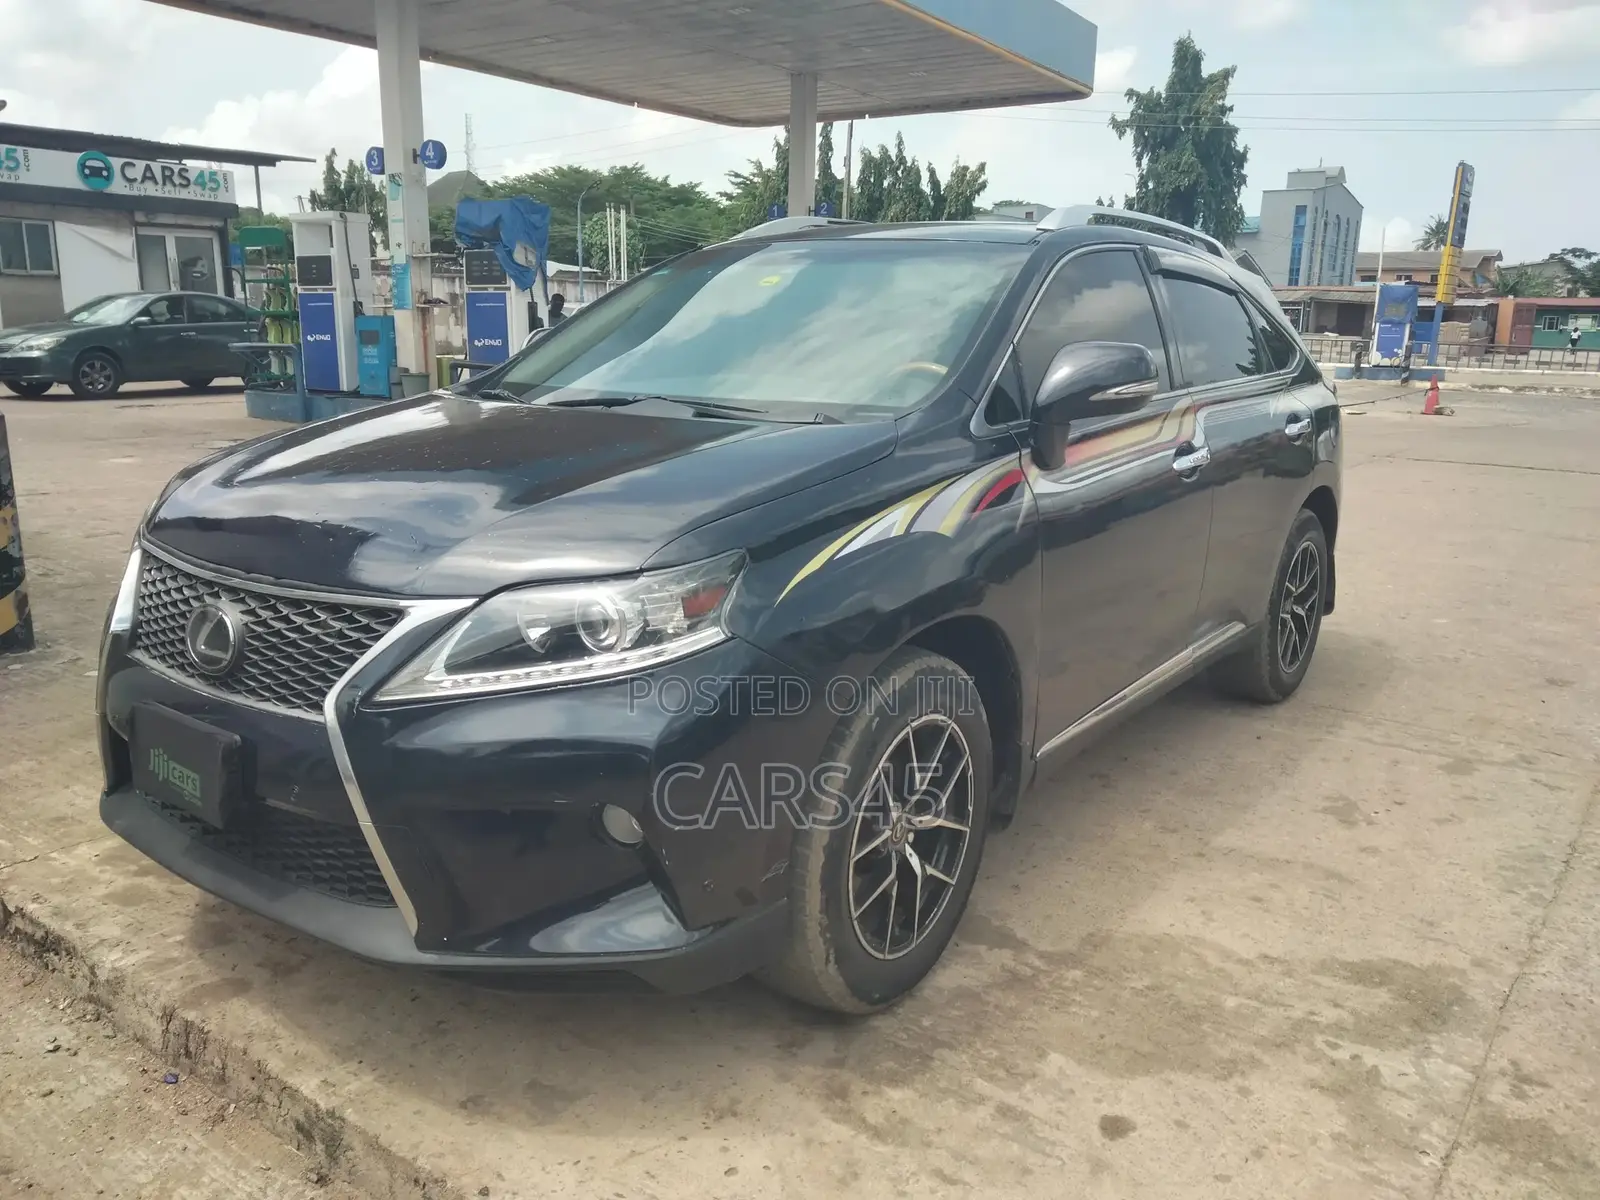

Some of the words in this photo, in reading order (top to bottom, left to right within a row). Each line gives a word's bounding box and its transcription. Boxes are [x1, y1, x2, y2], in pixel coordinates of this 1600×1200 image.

[371, 149, 379, 166] 3
[425, 141, 435, 160] 4
[0, 147, 21, 172] 5
[193, 190, 219, 200] Swap
[772, 205, 778, 217] 1
[820, 202, 828, 214] 2
